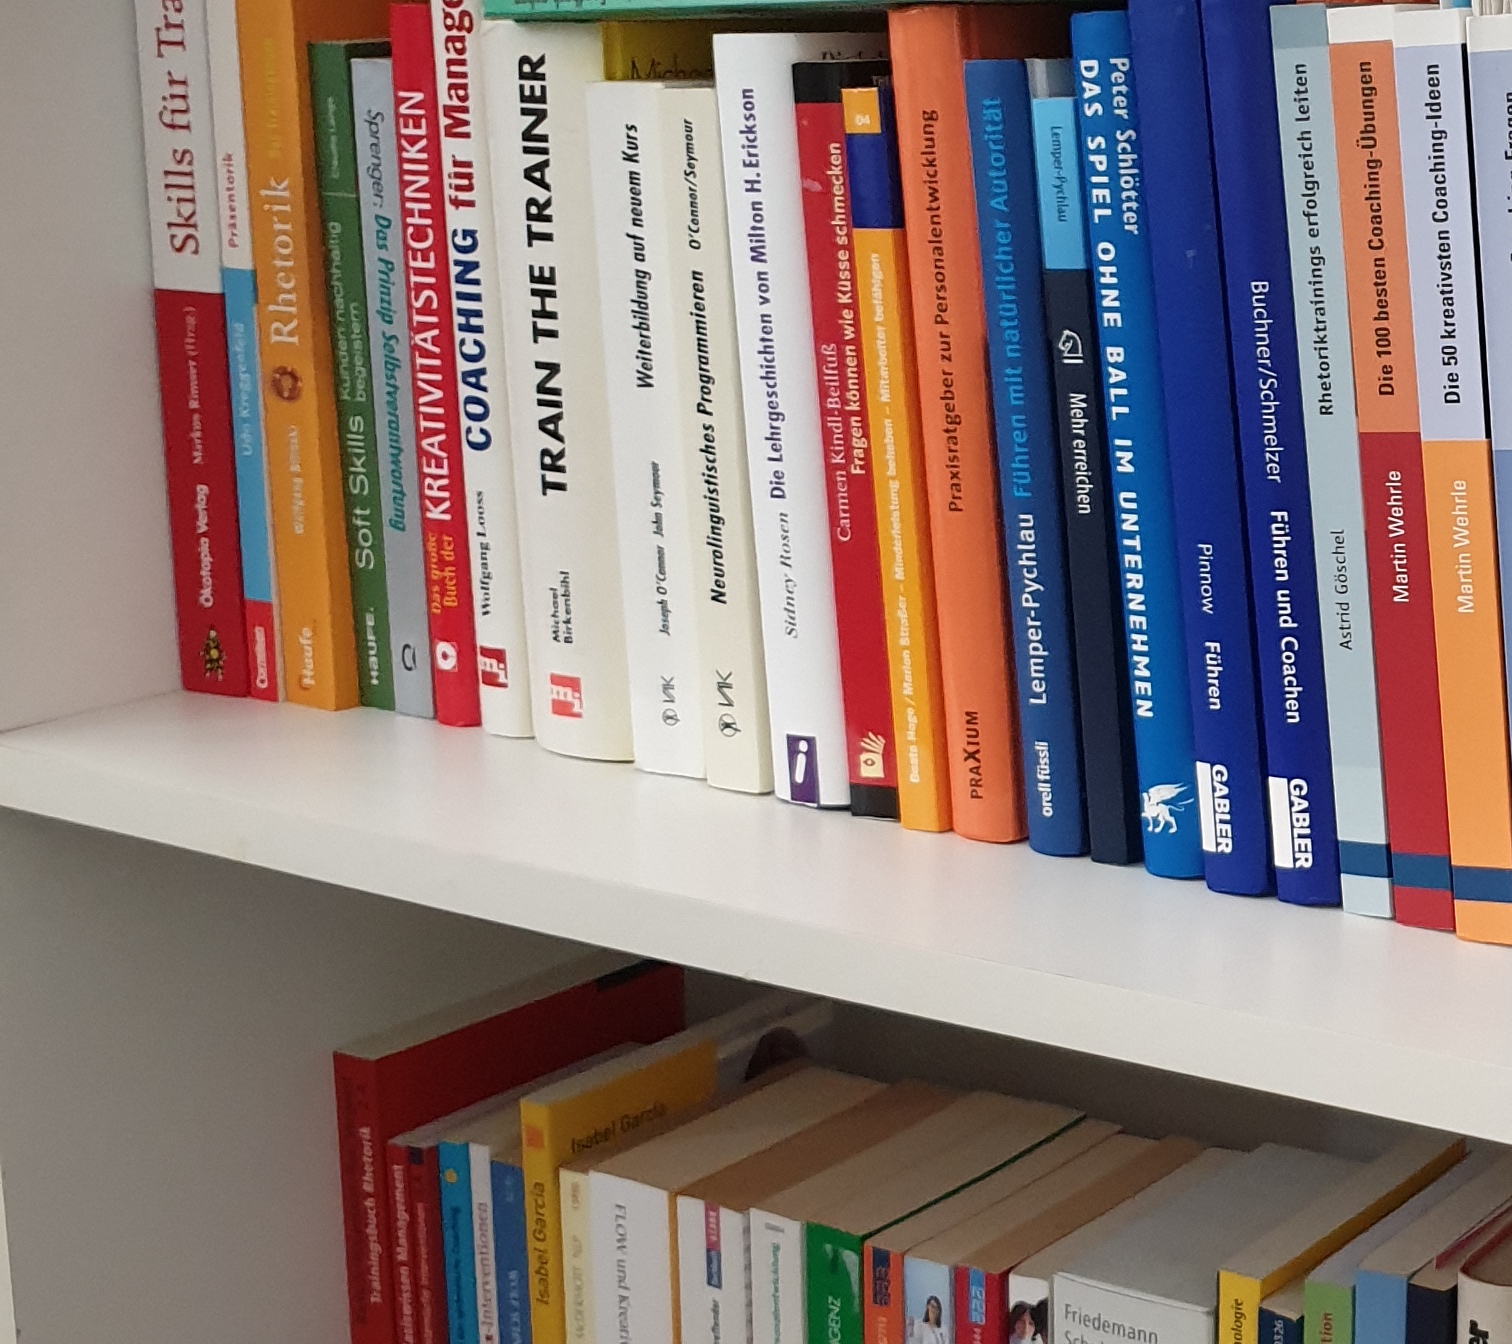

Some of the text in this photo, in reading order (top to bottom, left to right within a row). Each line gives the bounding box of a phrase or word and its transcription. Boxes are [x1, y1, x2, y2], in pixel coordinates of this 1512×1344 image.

[156, 69, 190, 132] für
[164, 147, 200, 254] Skills
[446, 154, 476, 210] für
[264, 177, 299, 344] Rhetorik
[397, 90, 451, 521] KREATIVITÄTSTECHNIKEN
[451, 228, 492, 451] COACHING
[517, 53, 569, 496] TRAIN THE TRAINER
[736, 88, 787, 499] Die Lehrgeschichten von Milton H. Erickson
[918, 109, 962, 512] Praxisratgeber zur Personalentwicklung
[1291, 64, 1335, 417] Rhetoriktrainings erfolgreich leiten
[347, 415, 373, 568] Soft Skills
[689, 270, 727, 604] Neurolinguistisches Programmieren
[980, 97, 1049, 705] Lemper-Pychlau Führen mit natürlicher Autorität
[1079, 59, 1154, 717] DAS SPIEL OHNE BALL IM UNTERNEHMEN
[1384, 470, 1408, 603] Martin Wehrle
[1212, 764, 1231, 853] GABLER
